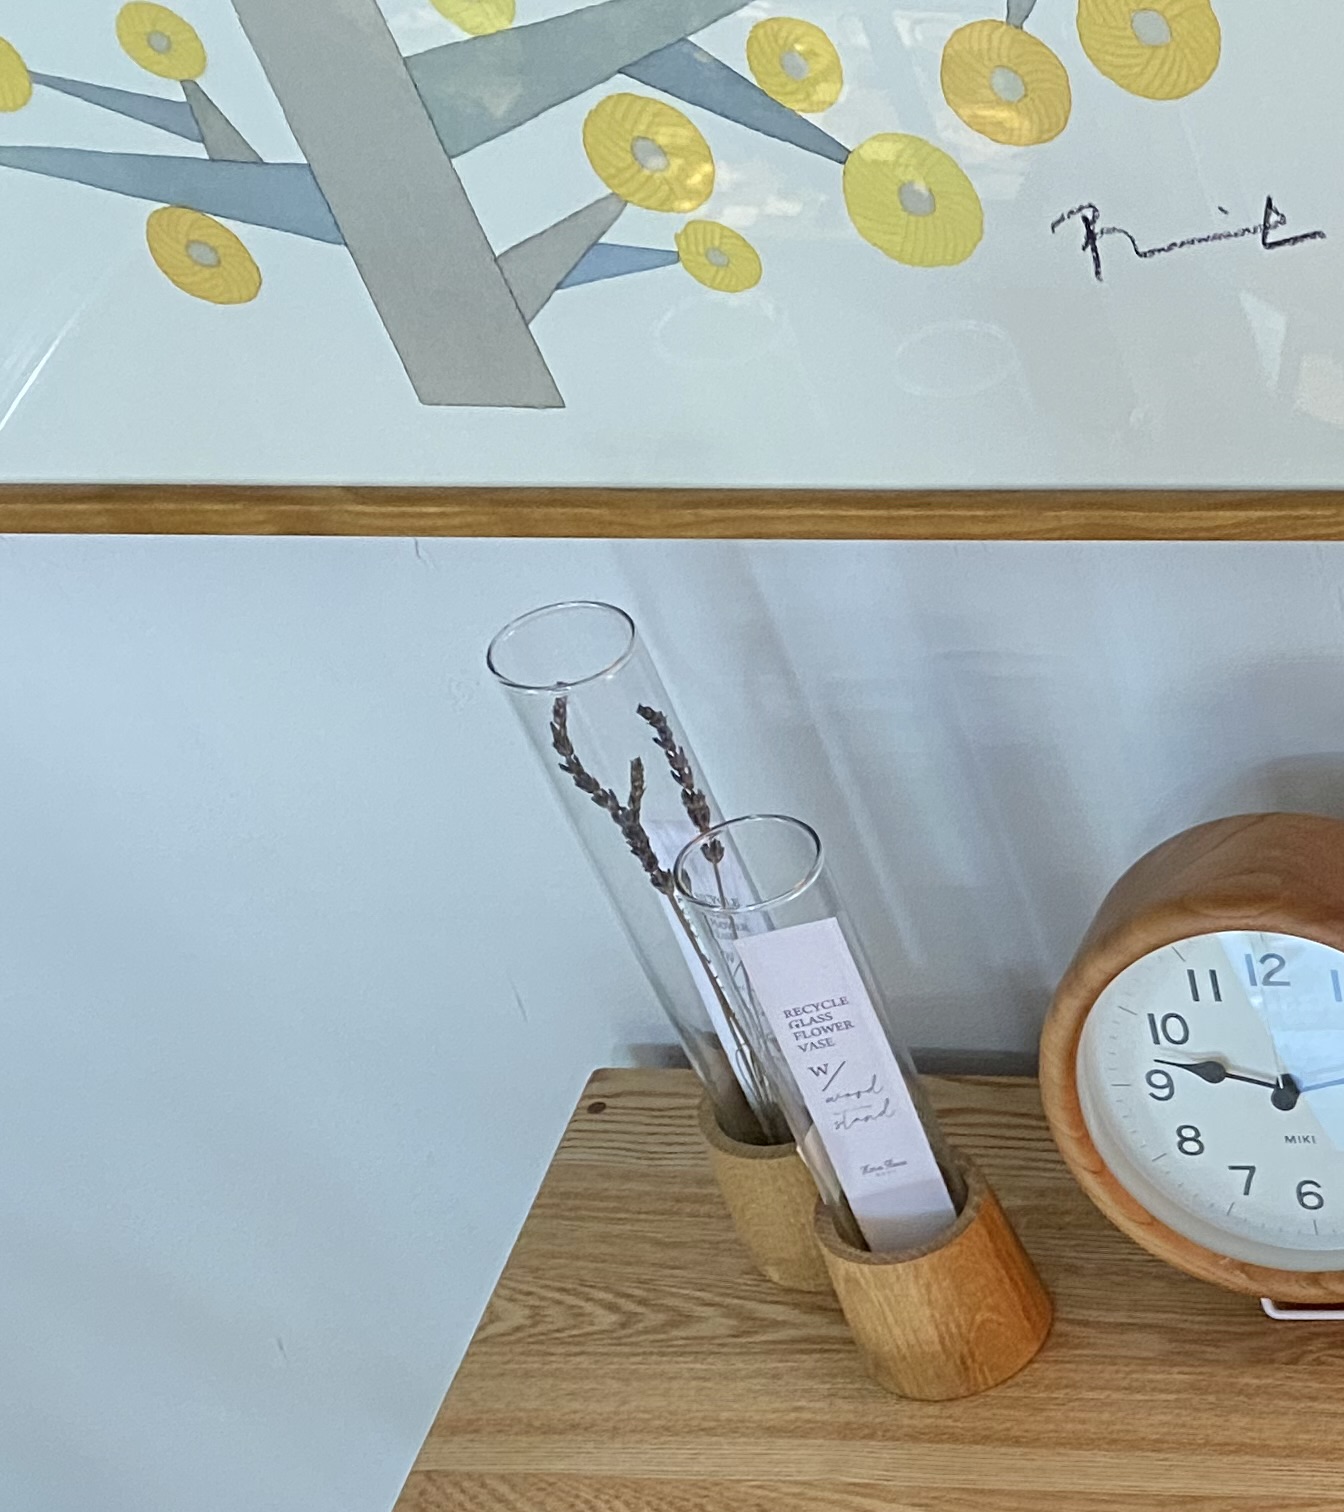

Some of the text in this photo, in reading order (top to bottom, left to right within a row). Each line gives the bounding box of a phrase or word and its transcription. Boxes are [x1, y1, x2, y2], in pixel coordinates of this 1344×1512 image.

[1186, 968, 1223, 1002] 11
[1244, 952, 1291, 987] 12
[1330, 969, 1344, 1002] 1
[782, 996, 850, 1019] RECYCLE
[788, 1011, 834, 1029] GLASS
[793, 1020, 855, 1041] FLOWER
[1147, 1011, 1190, 1045] 10
[797, 1037, 836, 1053] VASE
[1145, 1069, 1175, 1101] 9
[1176, 1125, 1205, 1156] 8
[1284, 1135, 1318, 1144] MIKI
[1228, 1165, 1256, 1196] 7
[1296, 1179, 1325, 1210] 6
